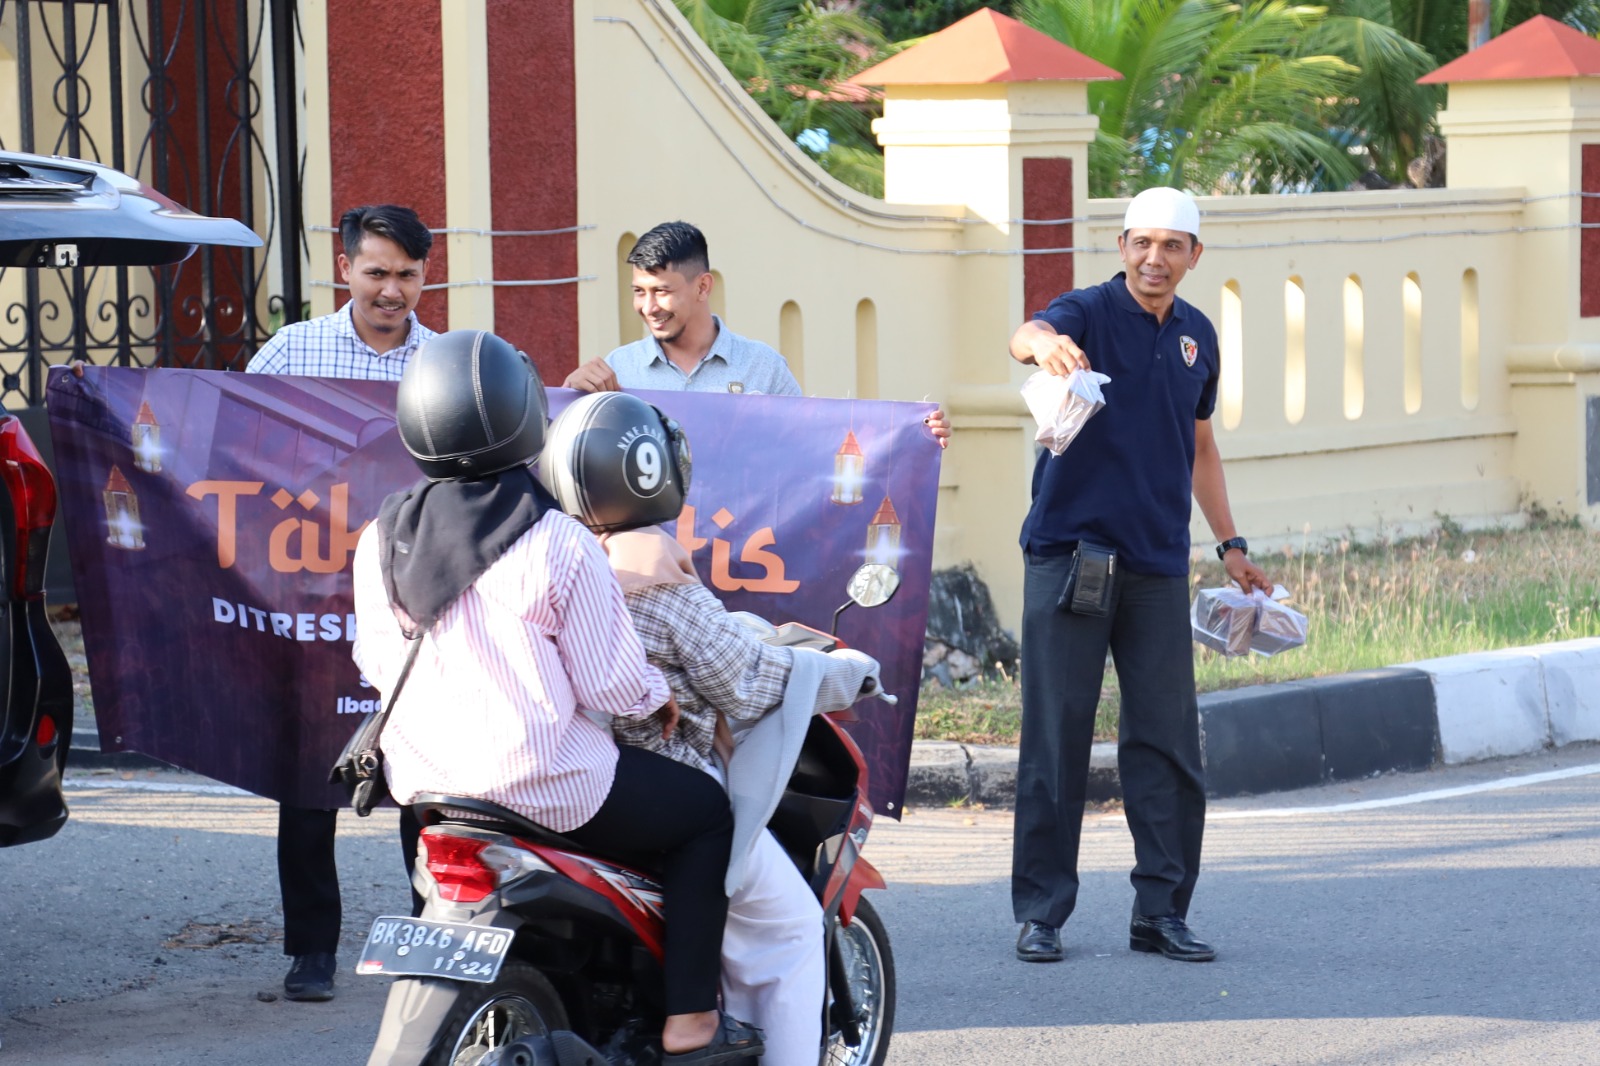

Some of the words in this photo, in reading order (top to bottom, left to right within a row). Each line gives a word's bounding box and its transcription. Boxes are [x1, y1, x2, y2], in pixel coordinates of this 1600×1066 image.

[636, 442, 661, 490] 9
[676, 504, 800, 593] tis
[372, 922, 401, 944] BK
[398, 924, 455, 948] 3846
